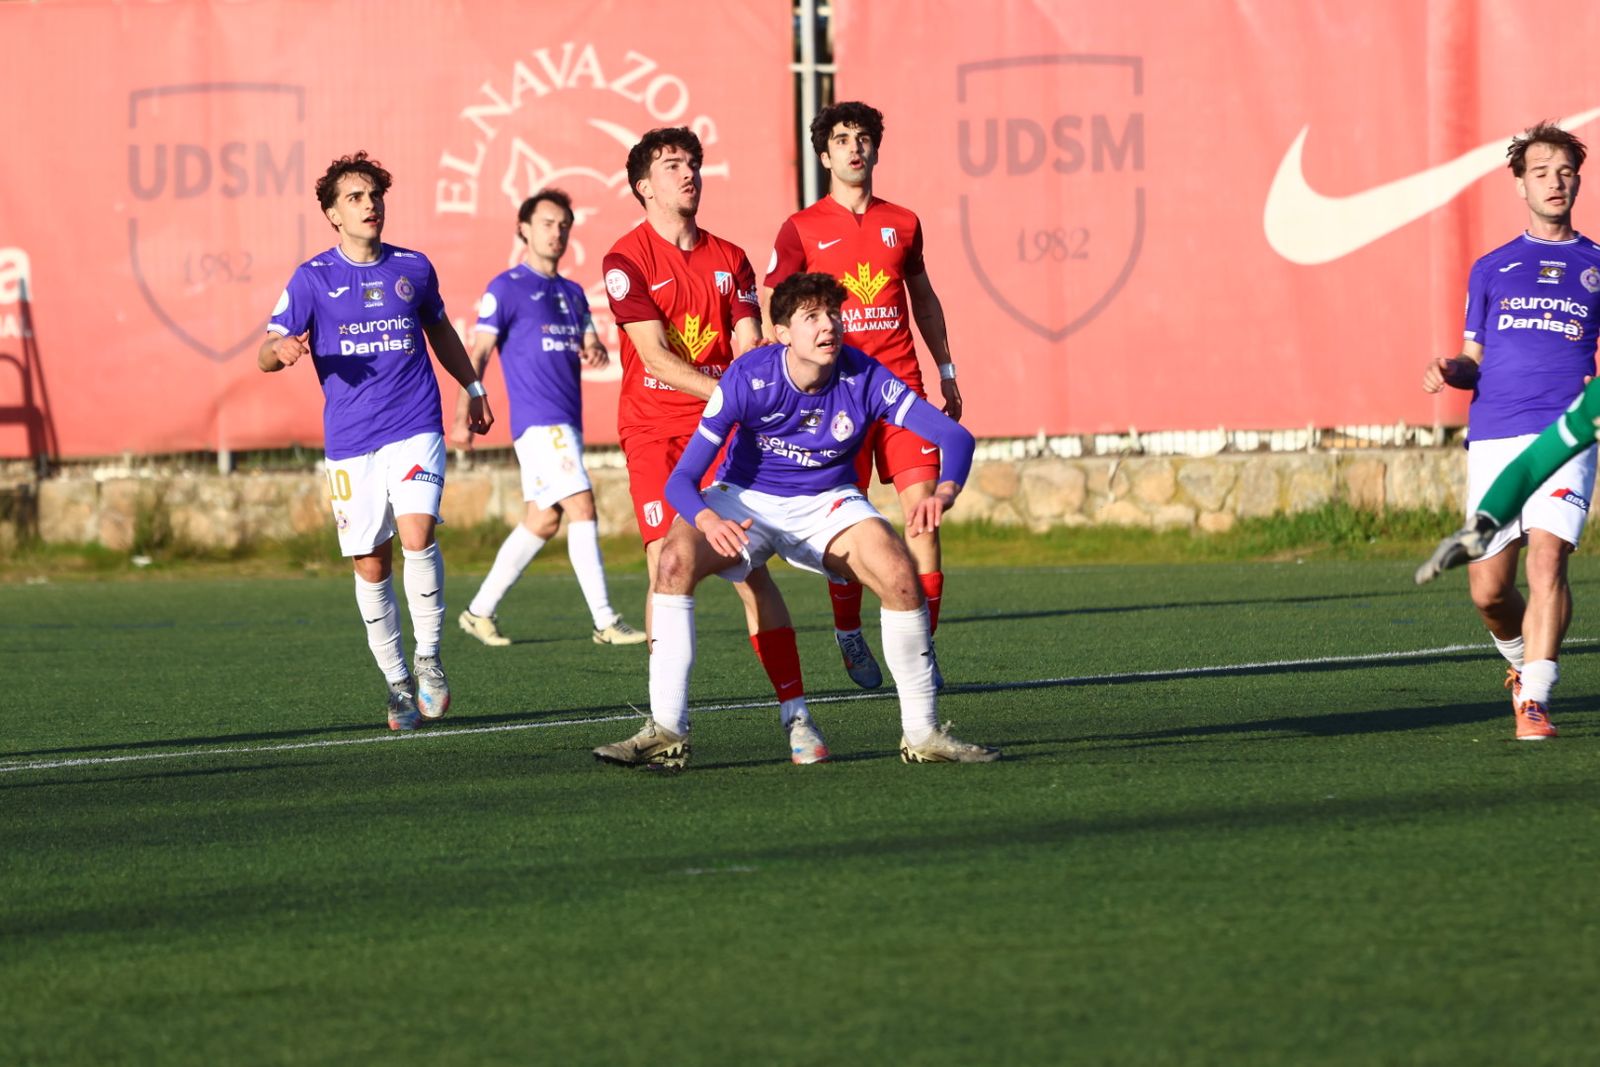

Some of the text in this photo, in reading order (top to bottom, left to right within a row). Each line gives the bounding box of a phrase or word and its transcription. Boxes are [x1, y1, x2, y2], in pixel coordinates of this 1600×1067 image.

[957, 112, 1146, 178] UDSM
[127, 140, 305, 201] UDSM
[1016, 227, 1090, 264] 1982
[184, 250, 253, 284] 1982
[841, 306, 899, 323] AJA RURAL
[1510, 297, 1588, 318] euronics
[349, 315, 414, 335] euronics
[848, 320, 899, 333] SALAMANCA
[1498, 312, 1580, 336] Danisa
[340, 334, 412, 356] Danisa
[550, 427, 567, 449] 2
